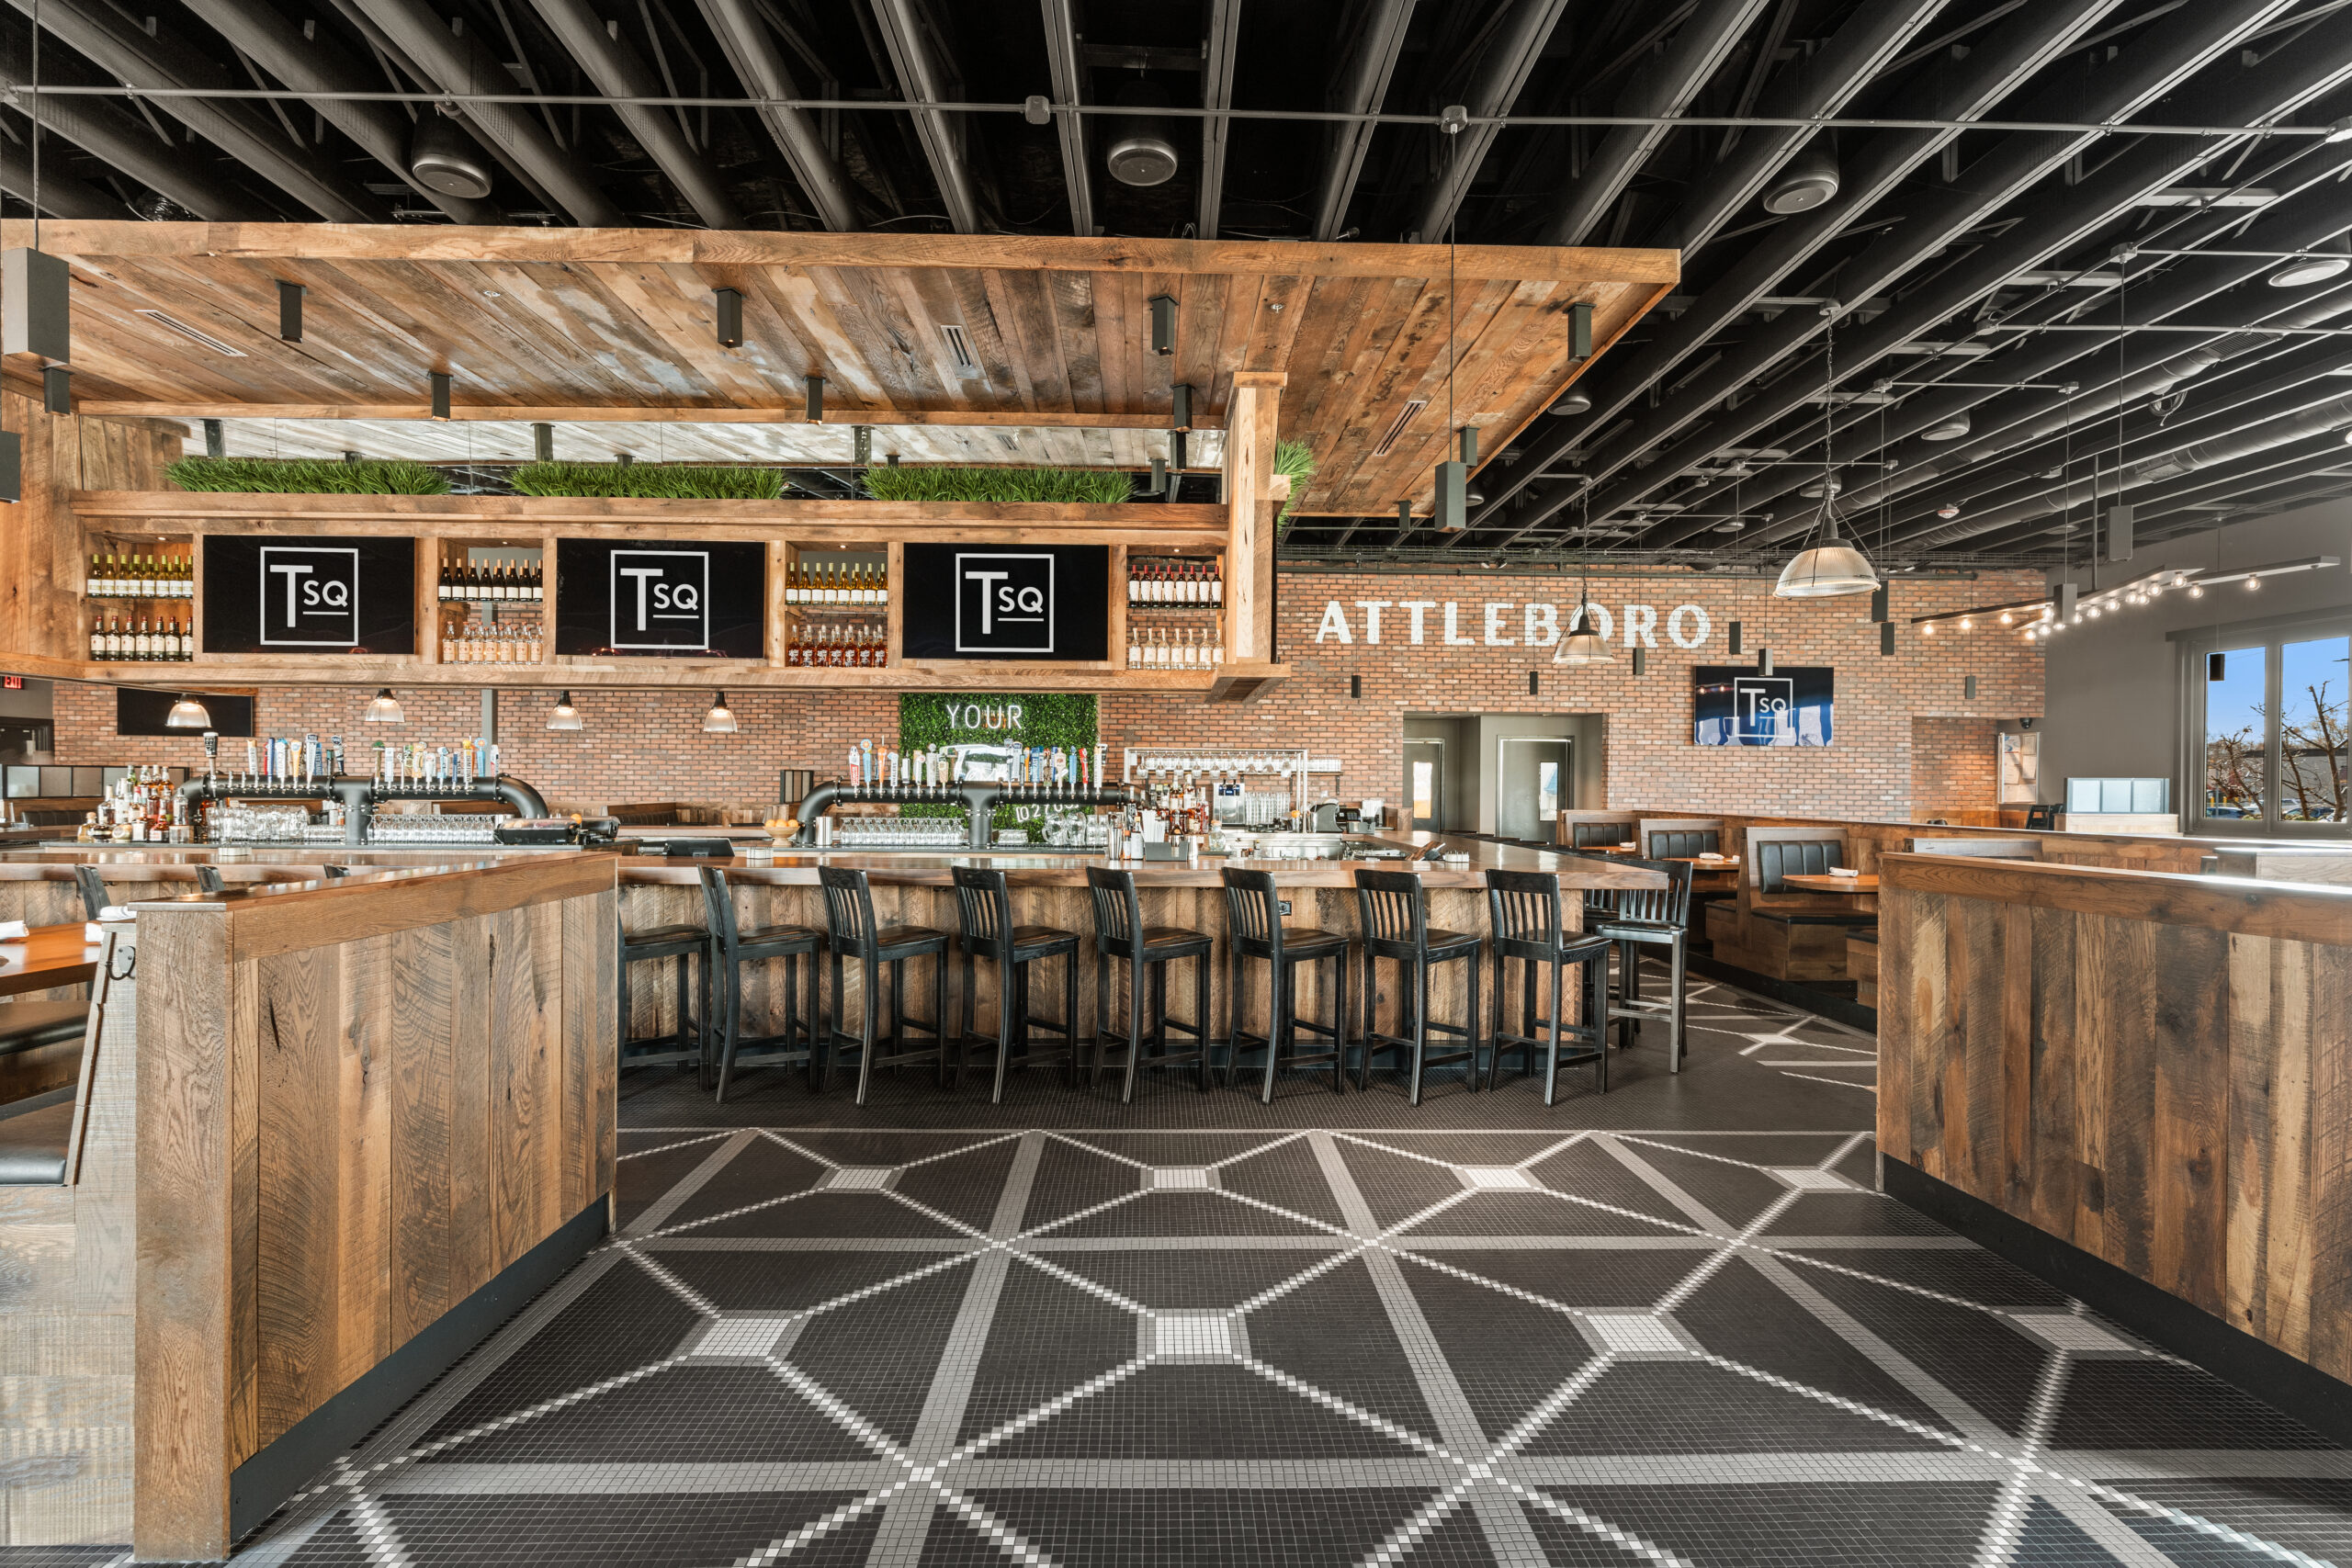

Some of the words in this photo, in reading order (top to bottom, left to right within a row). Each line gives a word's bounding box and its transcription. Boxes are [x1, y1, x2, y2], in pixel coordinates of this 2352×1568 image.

[1315, 600, 1712, 649] ATTLEBORO
[4, 675, 22, 689] EXIT
[946, 705, 1023, 729] YOUR
